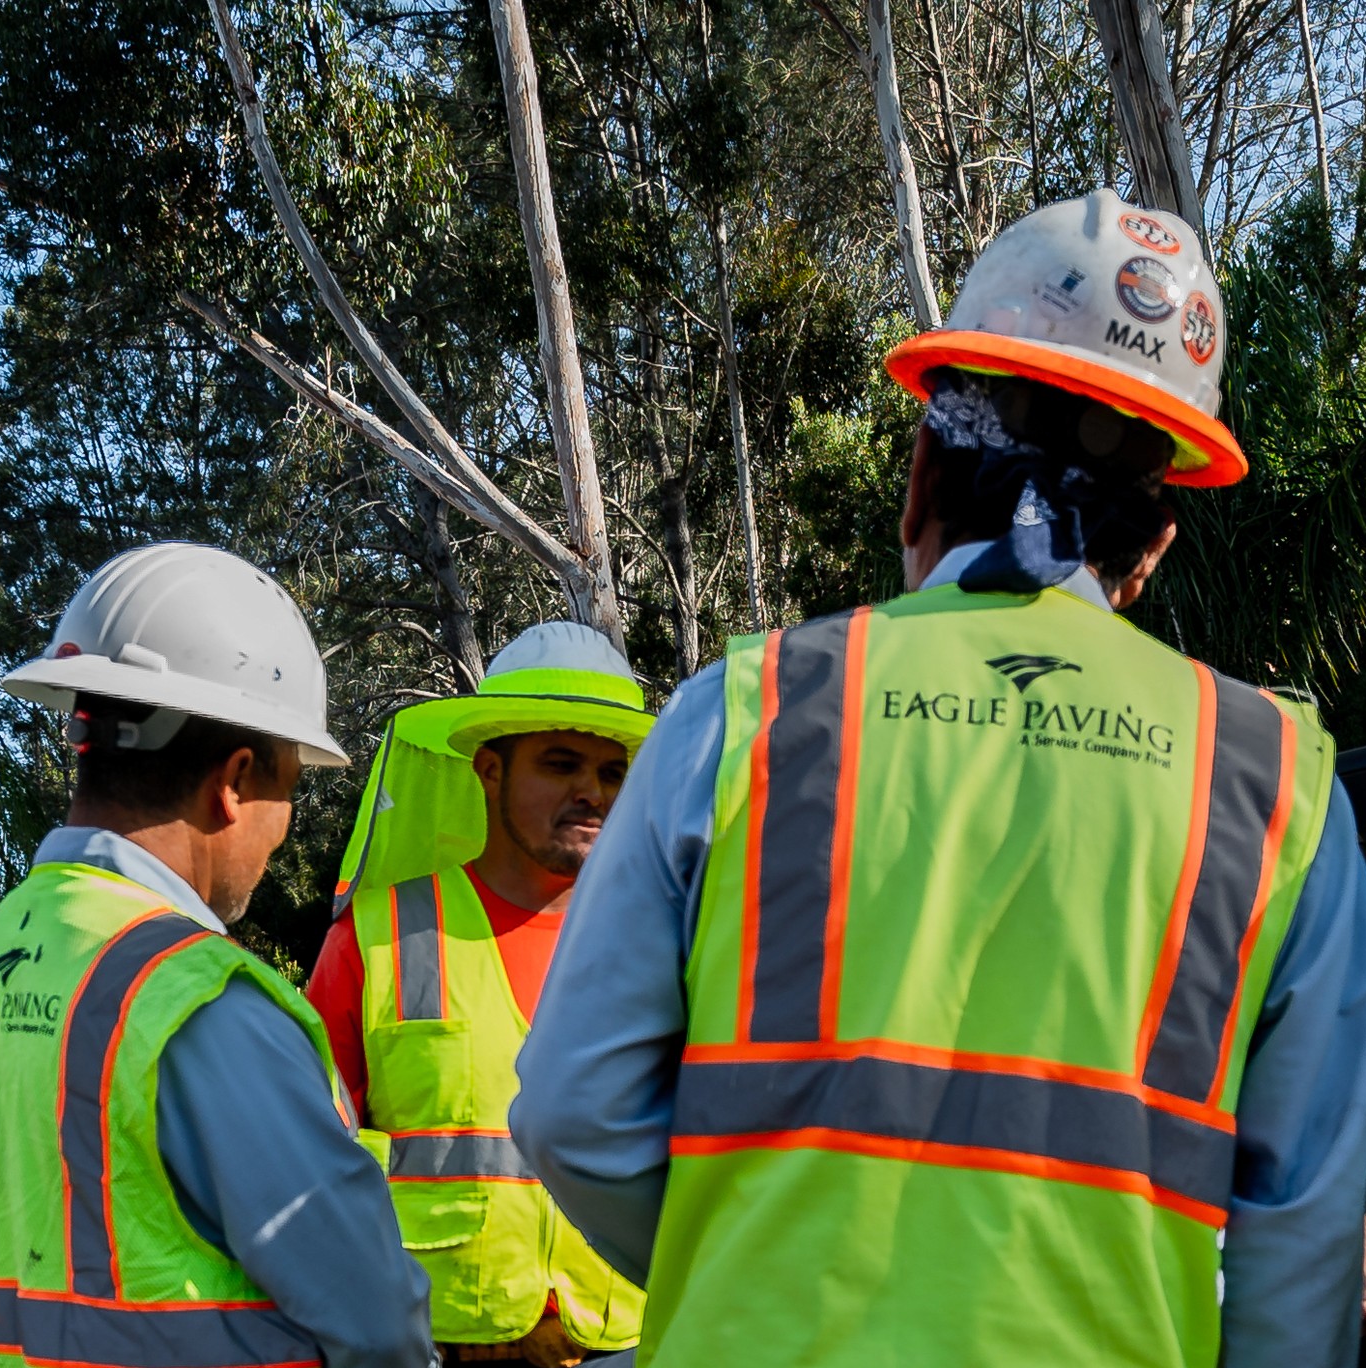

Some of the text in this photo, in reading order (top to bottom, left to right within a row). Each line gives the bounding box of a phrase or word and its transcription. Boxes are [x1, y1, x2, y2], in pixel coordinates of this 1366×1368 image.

[1105, 319, 1166, 363] MAX
[882, 690, 1174, 754] EAGLE PAVING
[1020, 734, 1030, 747] A
[1034, 733, 1079, 750] Service
[1083, 738, 1142, 762] Company
[1, 992, 60, 1022] PAVING
